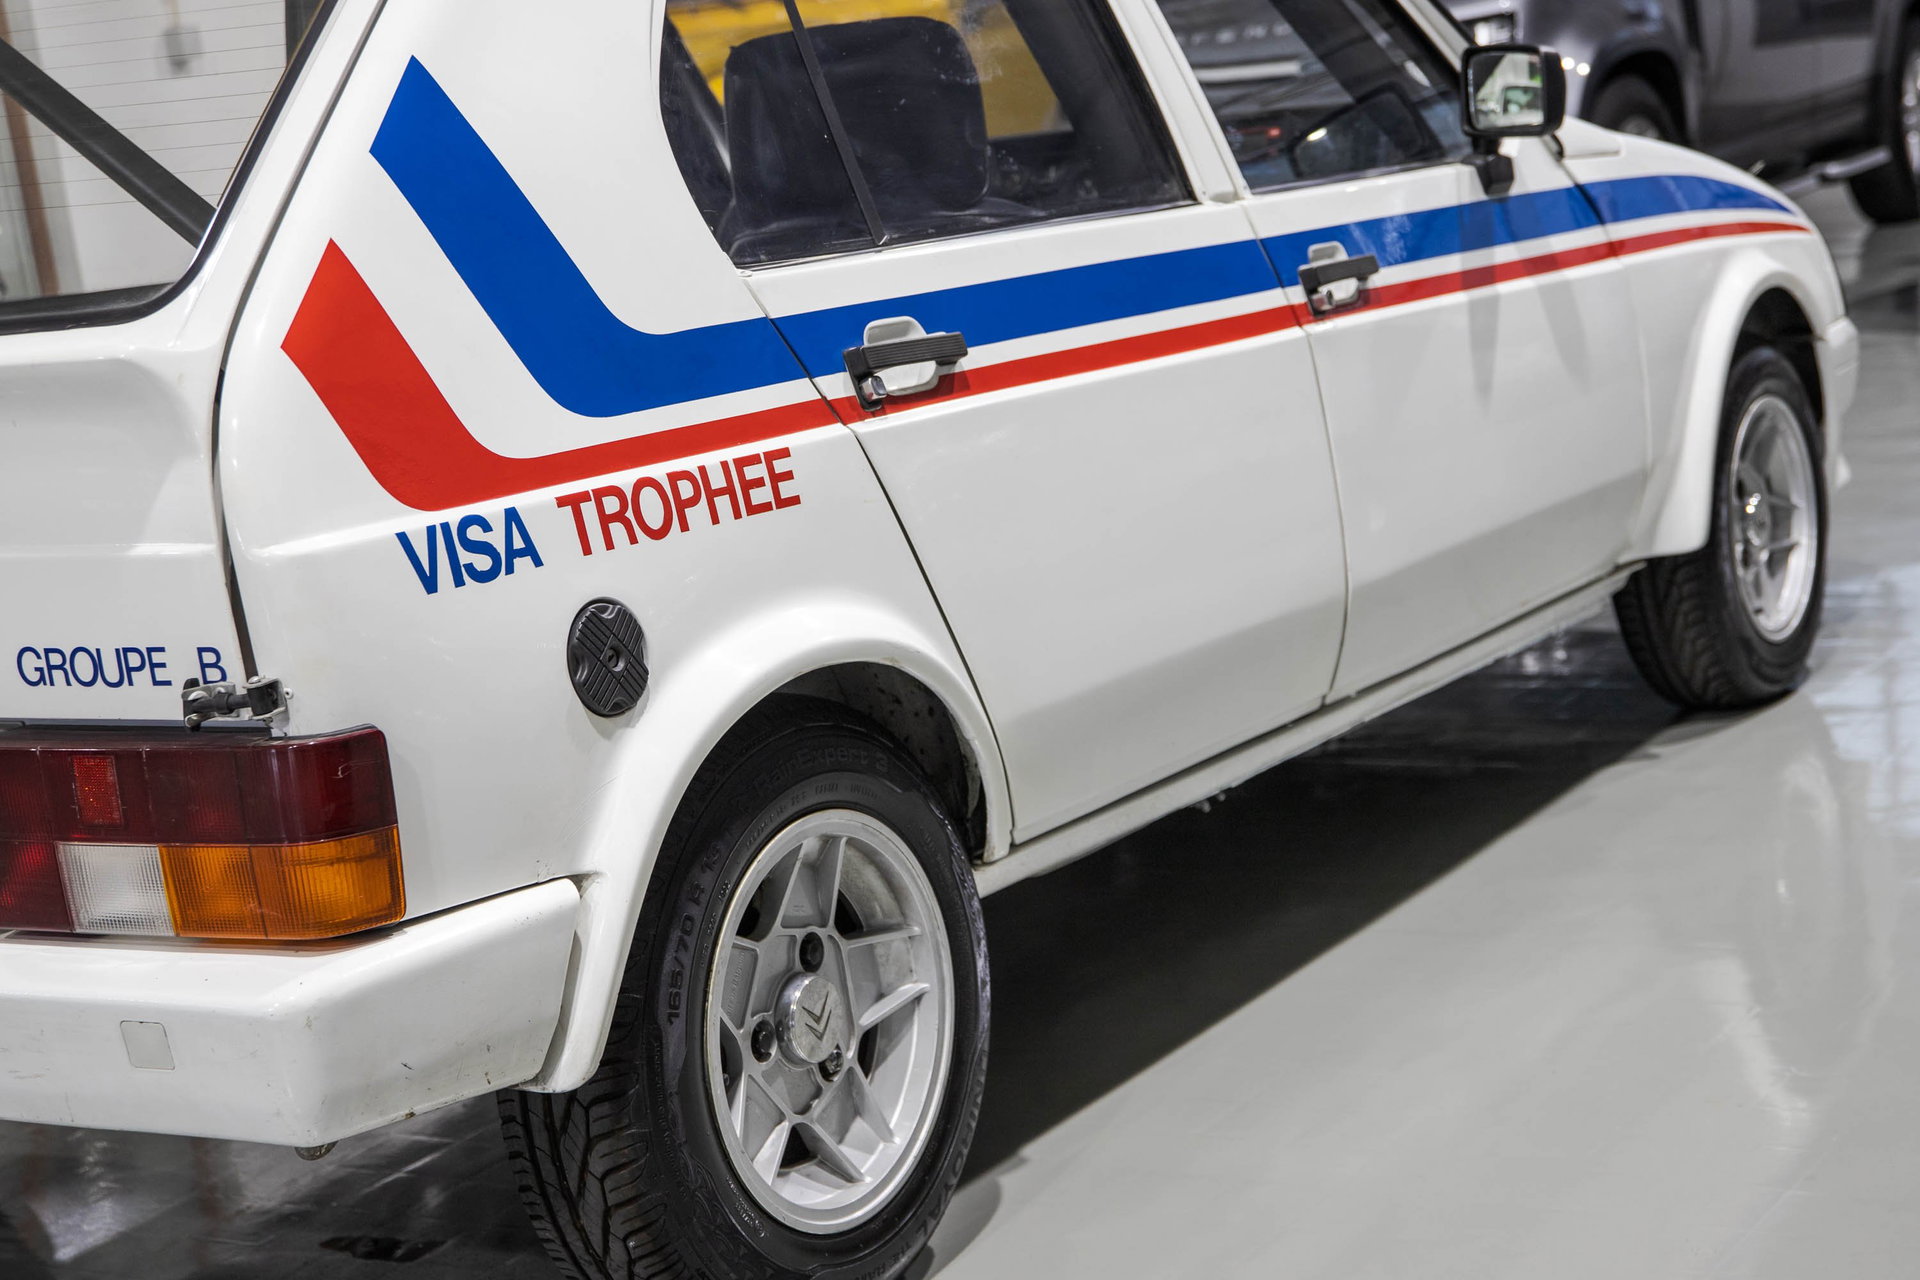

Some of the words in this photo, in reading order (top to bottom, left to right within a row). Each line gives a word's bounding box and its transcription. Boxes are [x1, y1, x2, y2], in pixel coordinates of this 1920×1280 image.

[395, 506, 543, 595] VISA
[555, 447, 801, 557] TROPHEE
[17, 646, 173, 688] GROUPE
[197, 646, 228, 685] B
[664, 913, 696, 1025] 165/70
